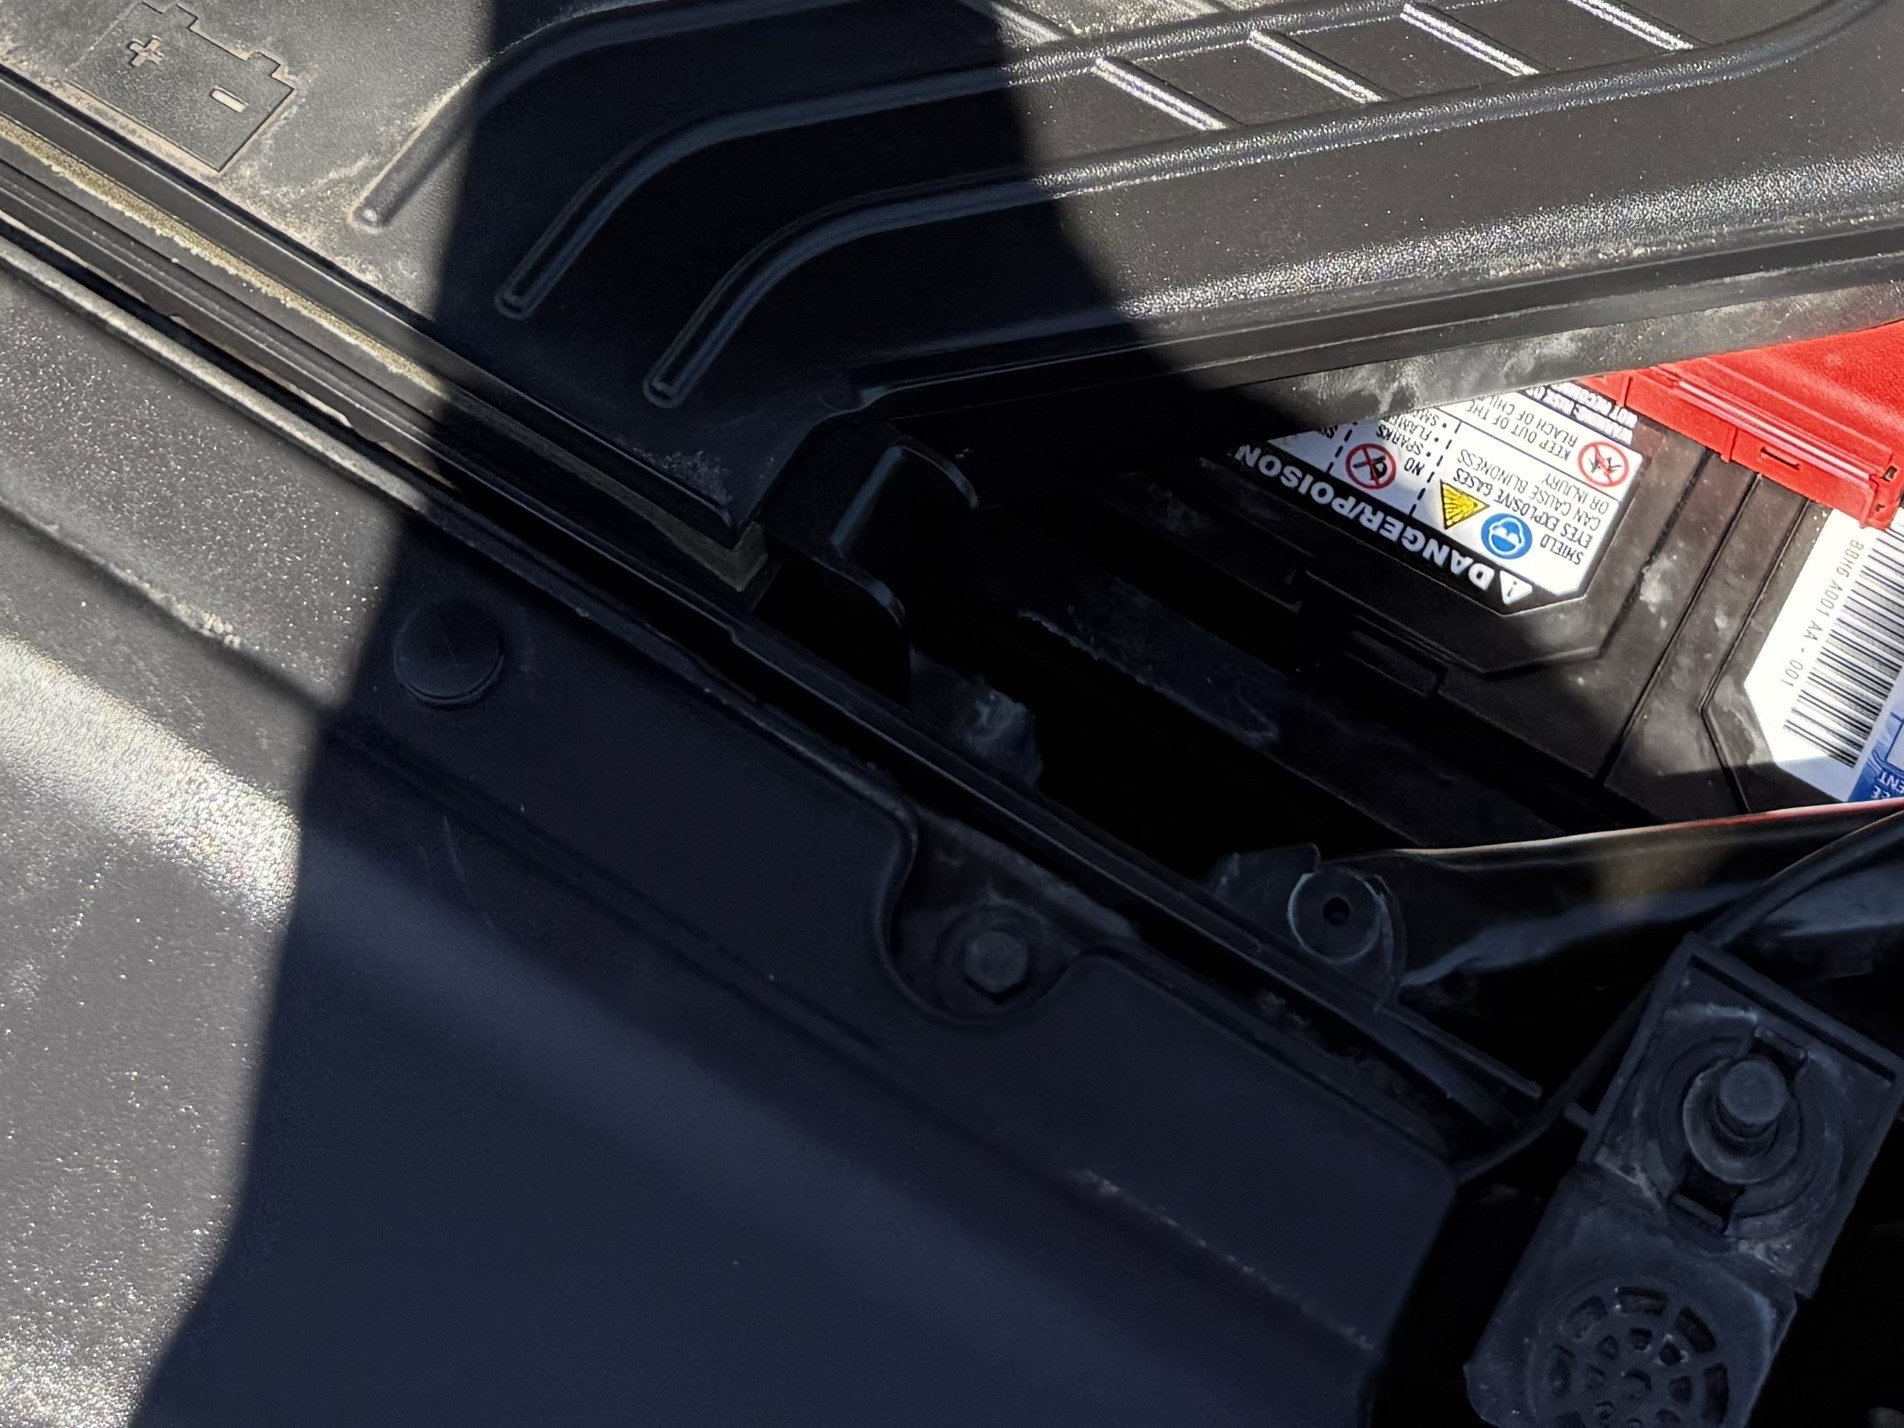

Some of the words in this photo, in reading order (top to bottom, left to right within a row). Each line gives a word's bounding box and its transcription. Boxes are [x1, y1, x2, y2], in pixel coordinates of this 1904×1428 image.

[1488, 410, 1510, 430] OF
[1510, 421, 1538, 444] OUT
[1515, 408, 1534, 425] OF
[1534, 416, 1579, 448] REACH
[1373, 421, 1424, 458] SPARKS
[1538, 435, 1571, 461] KEEP
[1402, 455, 1425, 477] NO
[1451, 465, 1494, 498] GASES
[1455, 445, 1528, 496] BLINDNESS
[1527, 484, 1572, 518] CAUSE
[1540, 470, 1589, 506] INJURY
[1232, 438, 1496, 591] DANGER/POISON
[1492, 486, 1560, 533] EXPLOSIVE
[1571, 506, 1602, 532] CAN
[1588, 495, 1610, 516] OR
[1538, 532, 1584, 566] SHIELD
[1558, 521, 1593, 549] EYES
